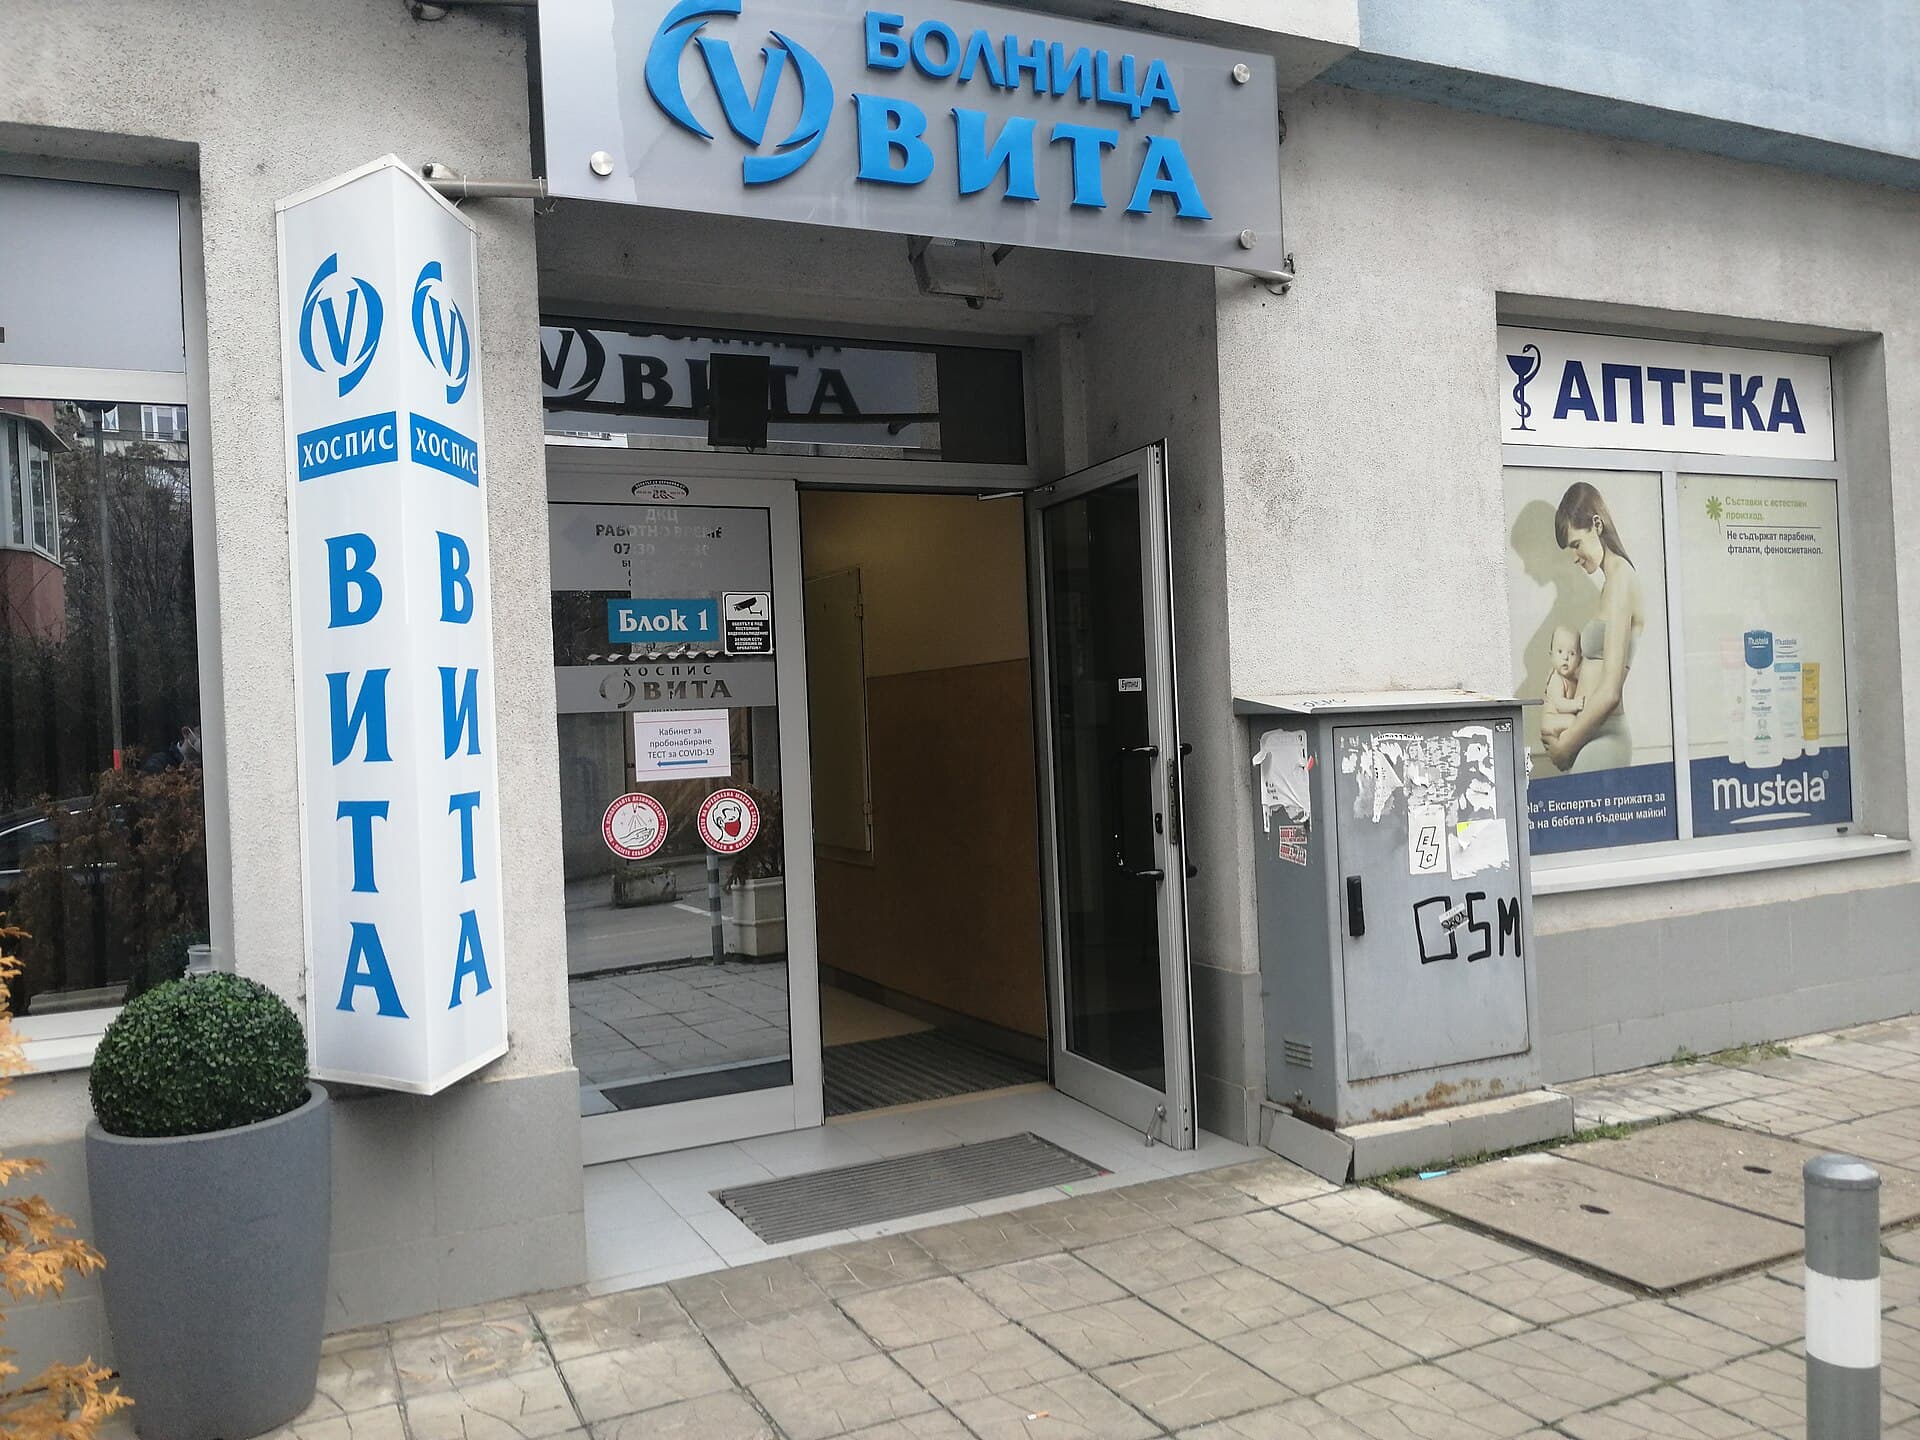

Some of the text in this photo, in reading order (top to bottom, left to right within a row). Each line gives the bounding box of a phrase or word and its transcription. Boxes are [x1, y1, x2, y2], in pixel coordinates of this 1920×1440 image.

[864, 10, 1181, 119] БОЛНИЦА
[851, 92, 1213, 221] ВИТА
[1552, 359, 1806, 434] АПТЕКА
[302, 424, 394, 468] ХОСПИС
[415, 427, 478, 475] ХОСПИС
[1726, 530, 1816, 543] Не съдържат парабени,
[1727, 544, 1823, 556] фталати, феноксиетанол.
[618, 608, 709, 632] Блок 1
[623, 665, 712, 677] ХОСПИС
[643, 680, 733, 701] ВИТА
[649, 738, 712, 748] пробонабиране
[659, 728, 691, 736] Кабинет
[648, 751, 666, 759] ТЕСТ
[679, 748, 715, 757] COVID-19
[325, 533, 410, 1020] ВИТА
[435, 530, 493, 1010] ВИТА
[1548, 799, 1602, 811] Експертът
[1605, 798, 1611, 806] в
[1613, 794, 1652, 808] грижата
[1655, 793, 1666, 802] за
[1537, 819, 1549, 829] на
[1551, 816, 1585, 827] бебета
[1587, 815, 1593, 824] и
[1596, 812, 1634, 823] бъдещи
[1636, 806, 1667, 819] майки!
